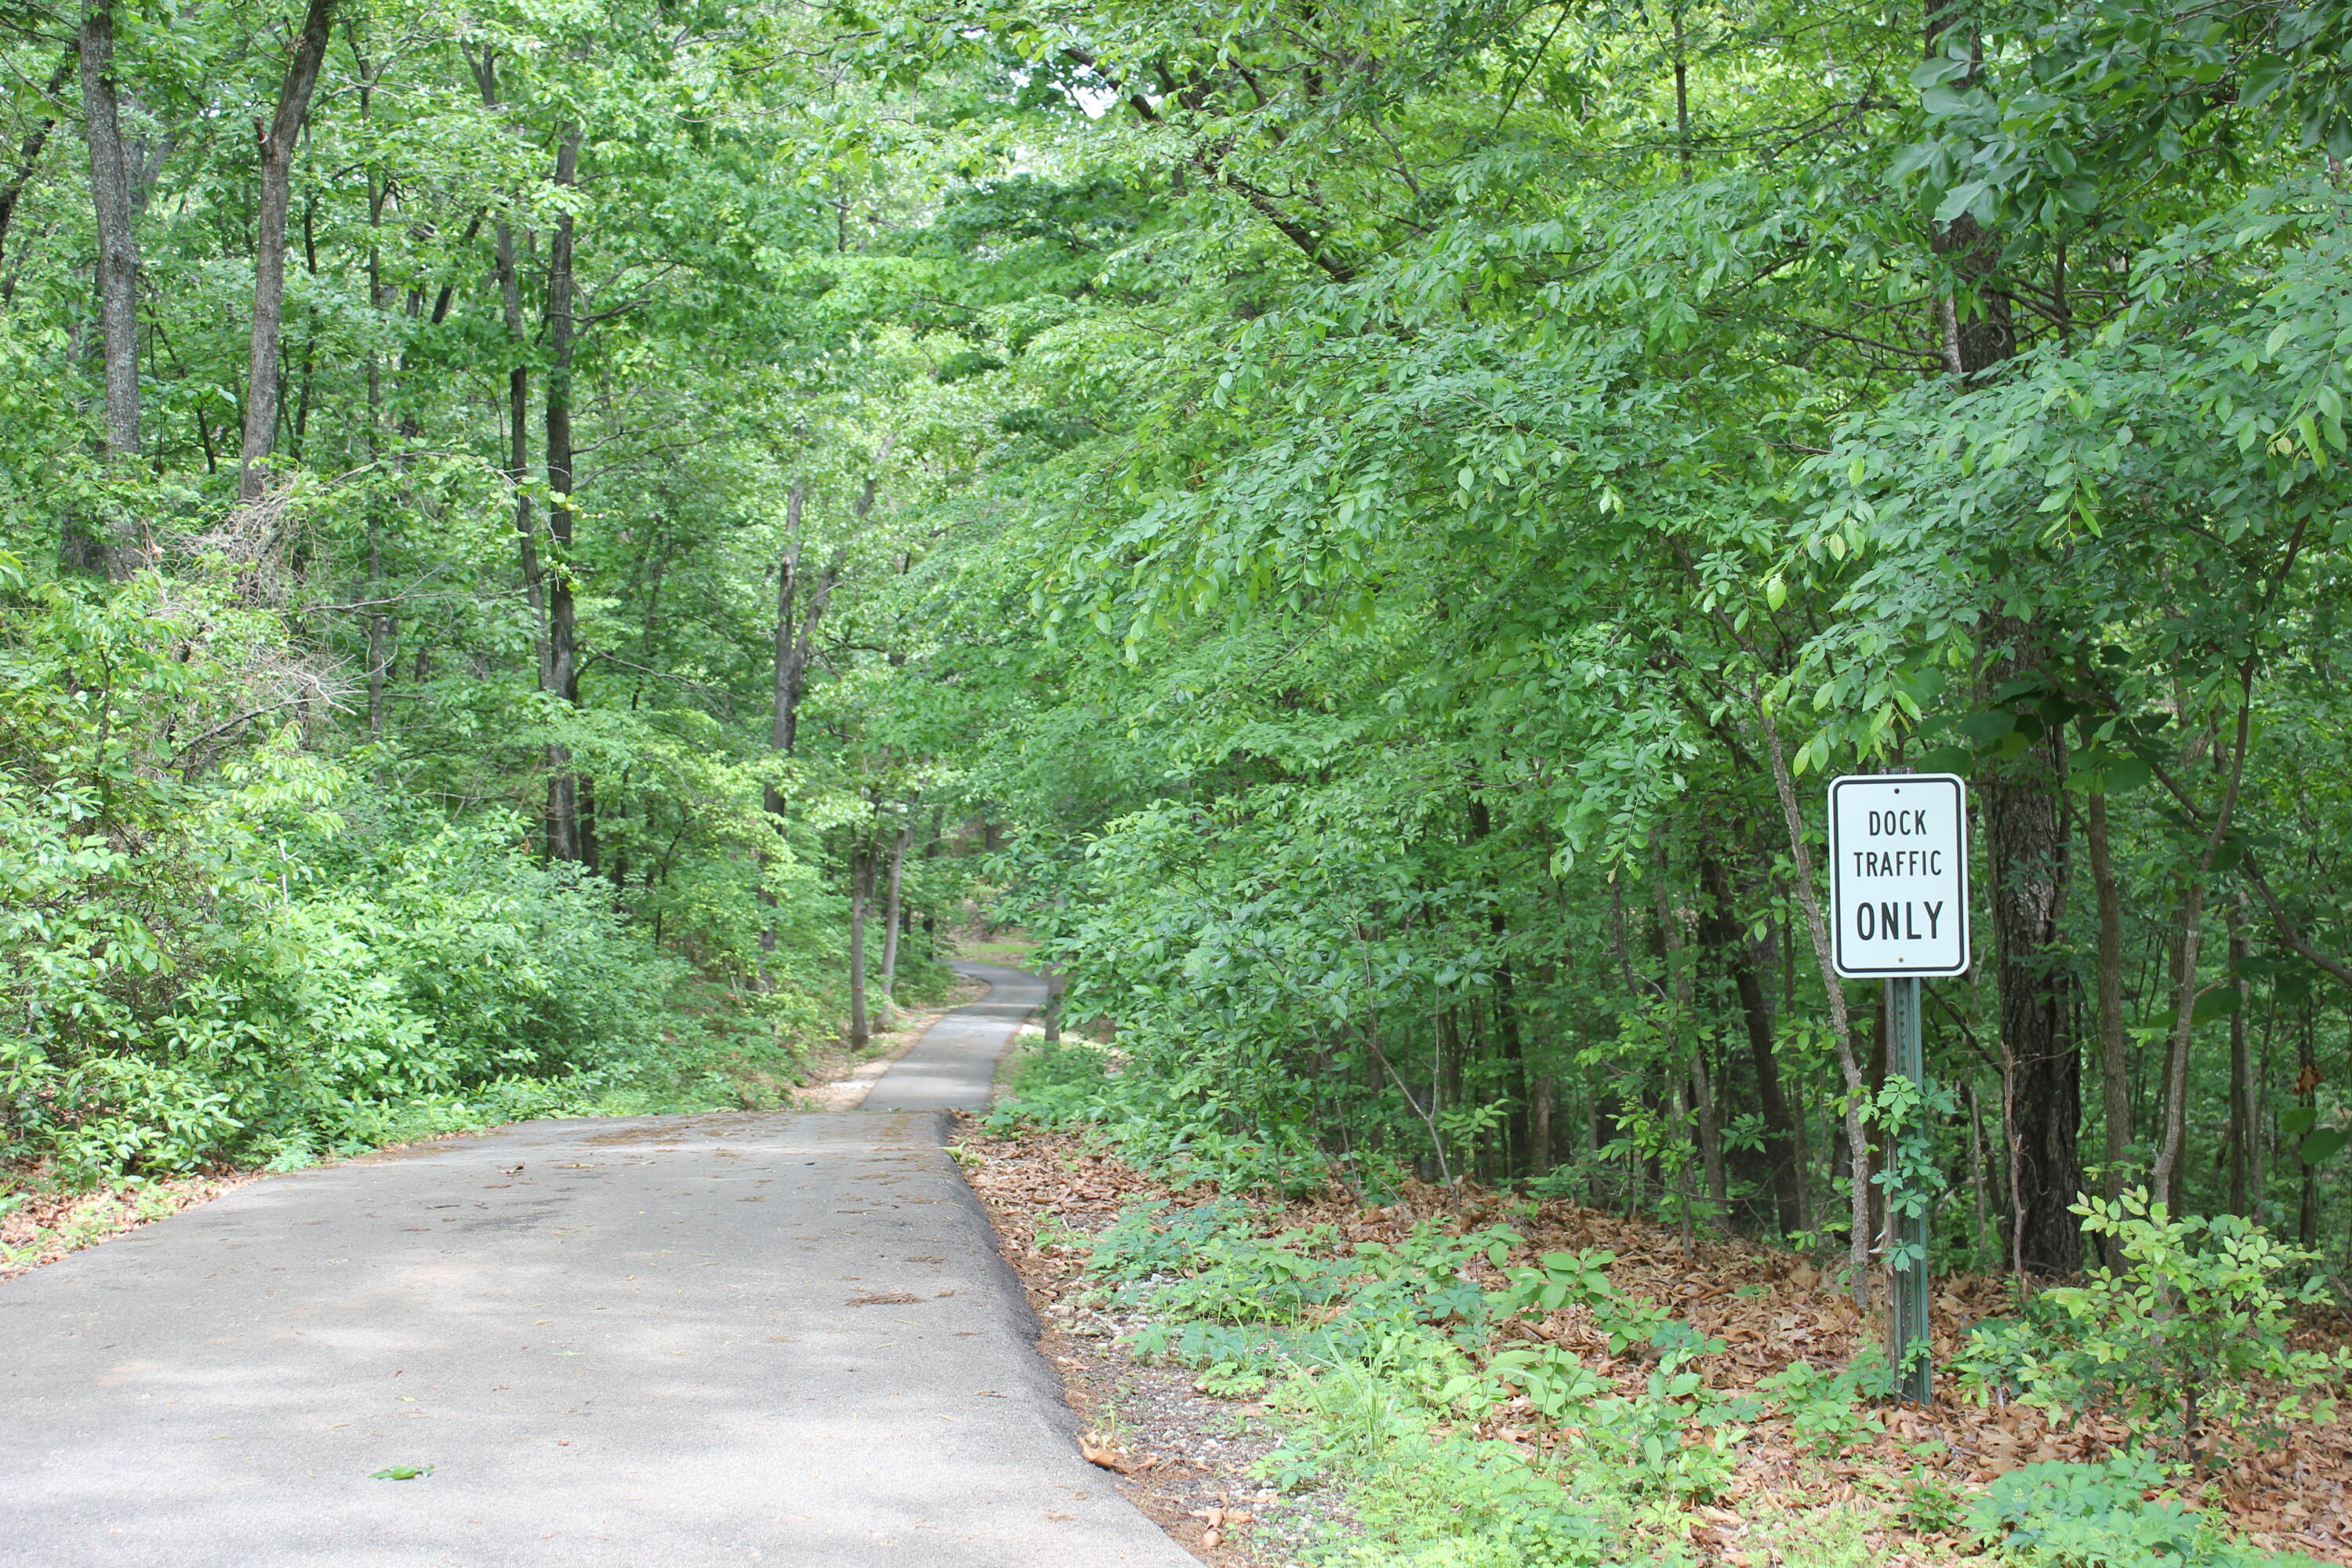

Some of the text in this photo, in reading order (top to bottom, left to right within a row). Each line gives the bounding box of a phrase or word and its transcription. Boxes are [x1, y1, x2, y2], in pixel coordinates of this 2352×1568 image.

[1869, 809, 1927, 837] DOCK
[1853, 850, 1942, 877] TRAFFIC
[1857, 901, 1944, 941] ONLY
